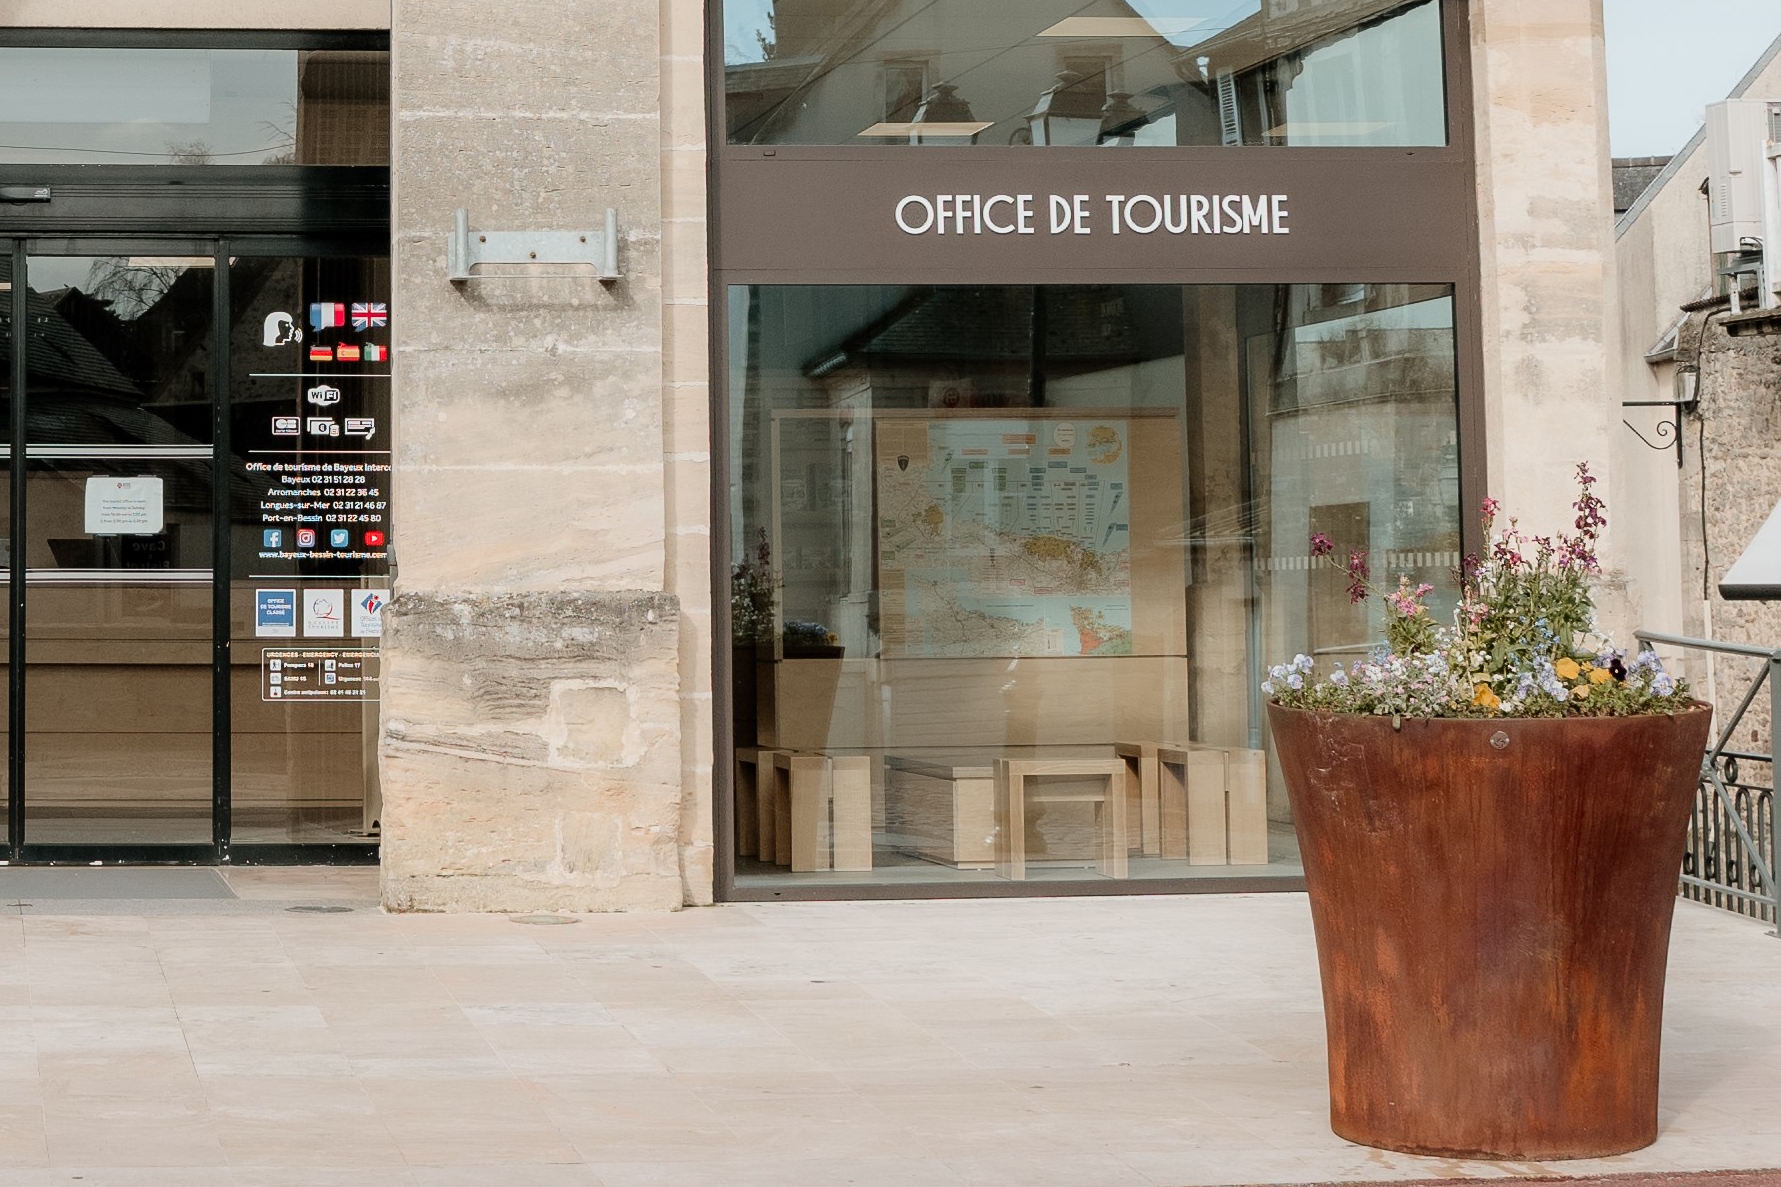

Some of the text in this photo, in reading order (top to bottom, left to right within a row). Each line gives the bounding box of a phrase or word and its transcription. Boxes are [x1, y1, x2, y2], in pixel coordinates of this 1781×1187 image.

[895, 194, 1290, 235] OFFICE DE TOURISME
[246, 463, 271, 471] Office
[284, 463, 320, 471] tourisme
[334, 464, 363, 473] Bayeux
[282, 476, 365, 485] Bayeux 02 31 51 28 28
[268, 488, 320, 496] Arromanches
[261, 501, 330, 510] Longues-sur-Mer
[263, 514, 322, 522] Port-en-Bessin
